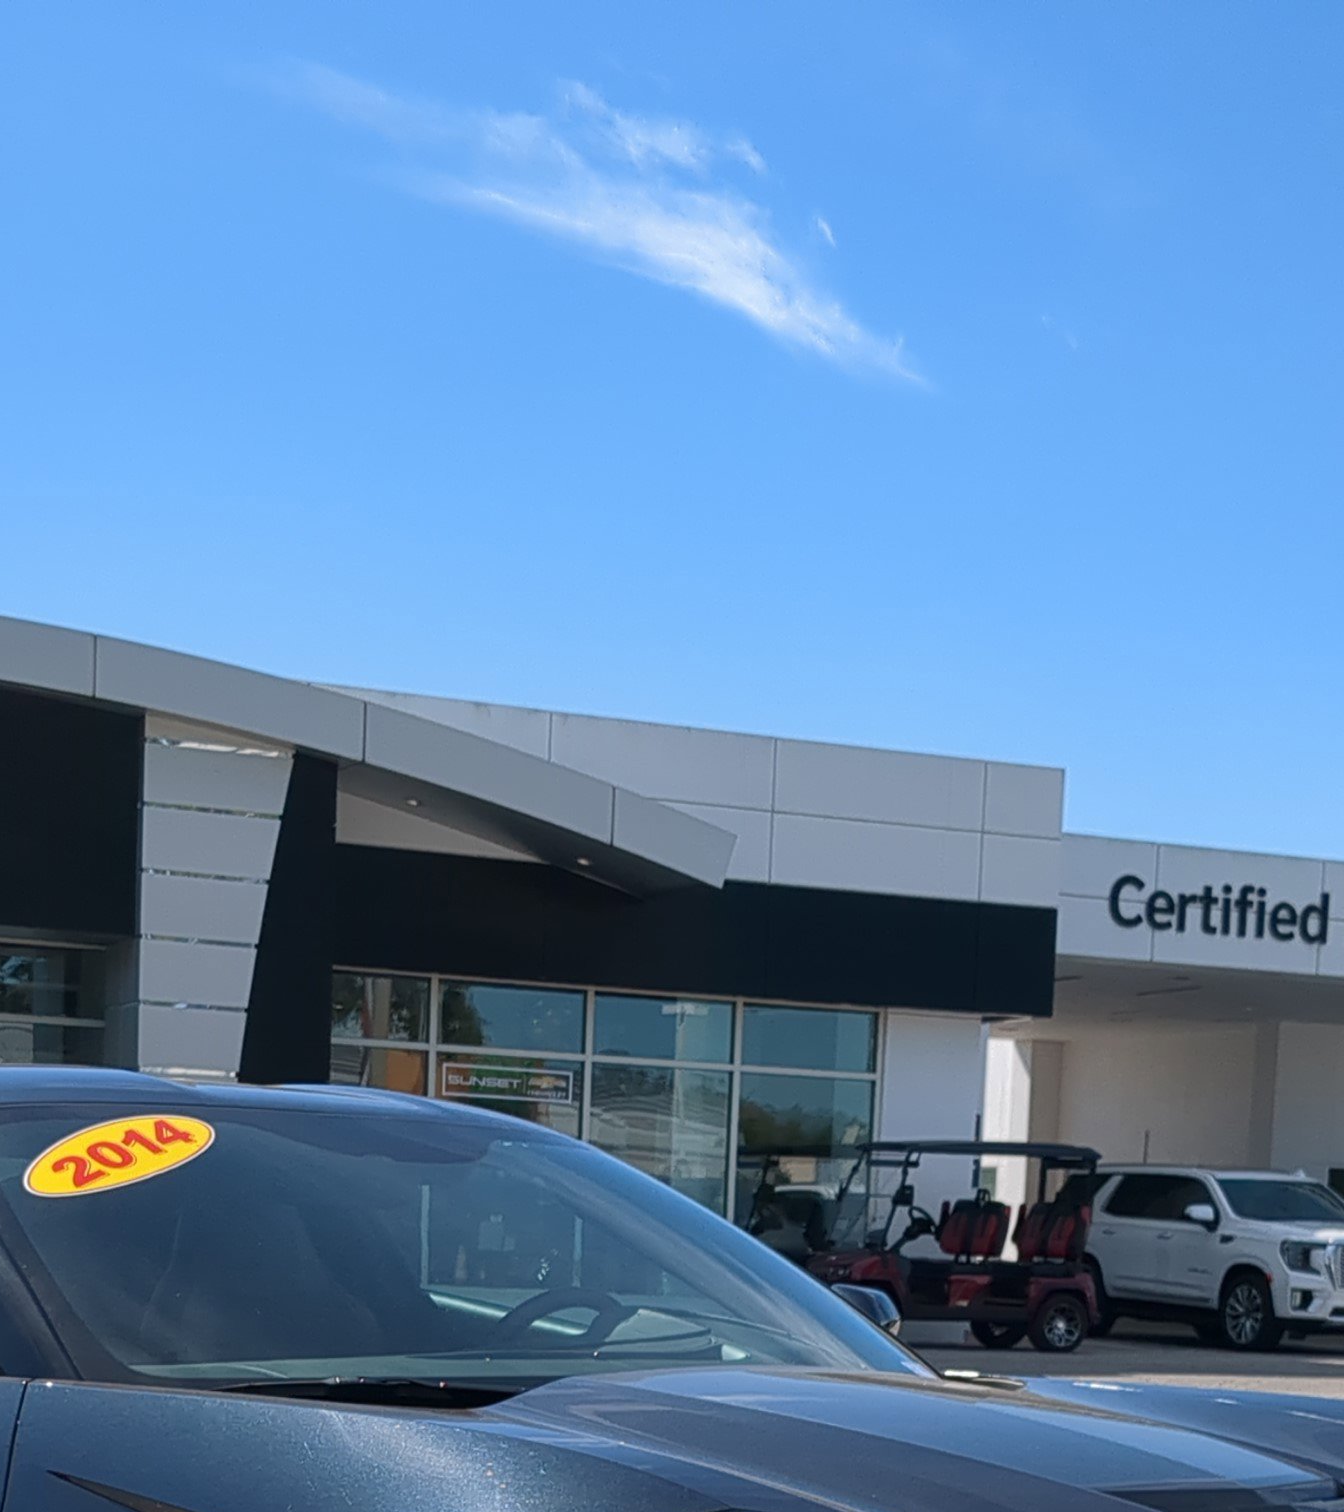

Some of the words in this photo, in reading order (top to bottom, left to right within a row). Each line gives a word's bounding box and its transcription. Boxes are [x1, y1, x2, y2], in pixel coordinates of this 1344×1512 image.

[1108, 874, 1331, 945] Certified
[447, 1074, 522, 1089] SUNSET
[52, 1119, 197, 1188] 2014
